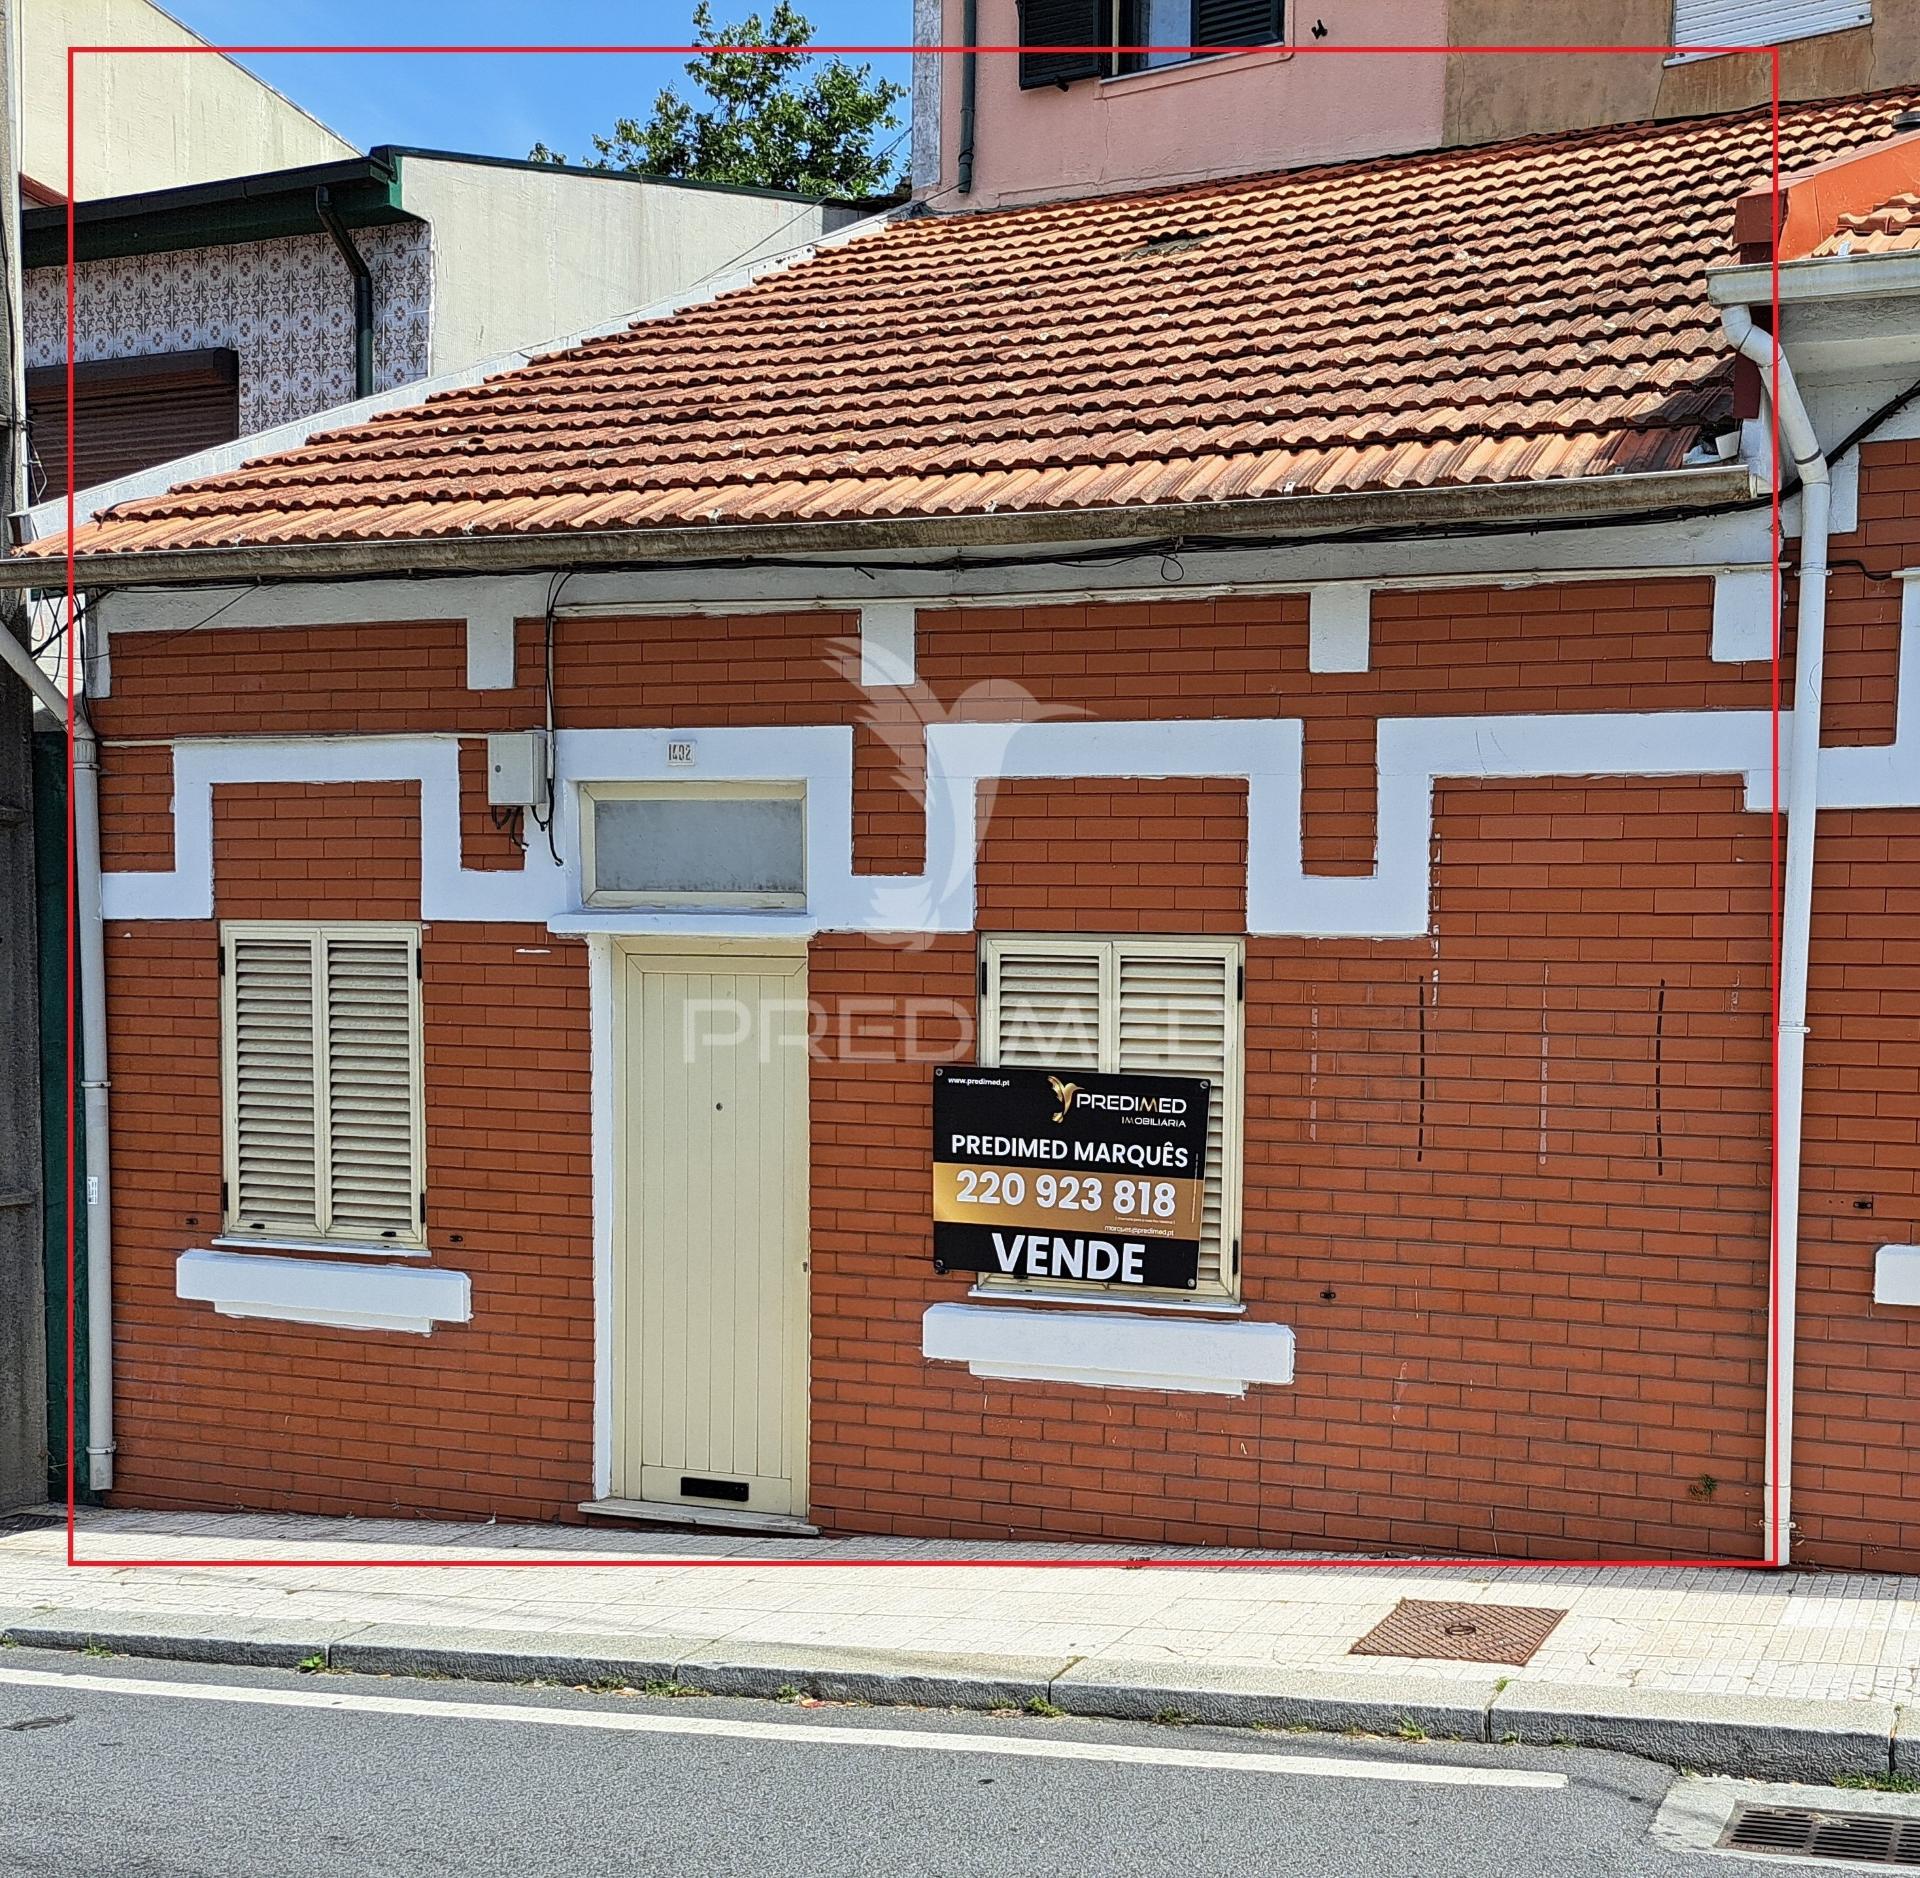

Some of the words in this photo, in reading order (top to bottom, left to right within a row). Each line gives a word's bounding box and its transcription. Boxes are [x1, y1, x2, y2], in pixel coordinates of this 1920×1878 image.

[1076, 1093, 1187, 1114] PREDIMED
[951, 1134, 1067, 1160] PREDIMED
[1074, 1141, 1188, 1168] MARQUÊS
[956, 1169, 1025, 1206] 220
[1035, 1174, 1102, 1212] 923
[1112, 1179, 1176, 1217] 818
[991, 1232, 1146, 1284] VENDE
